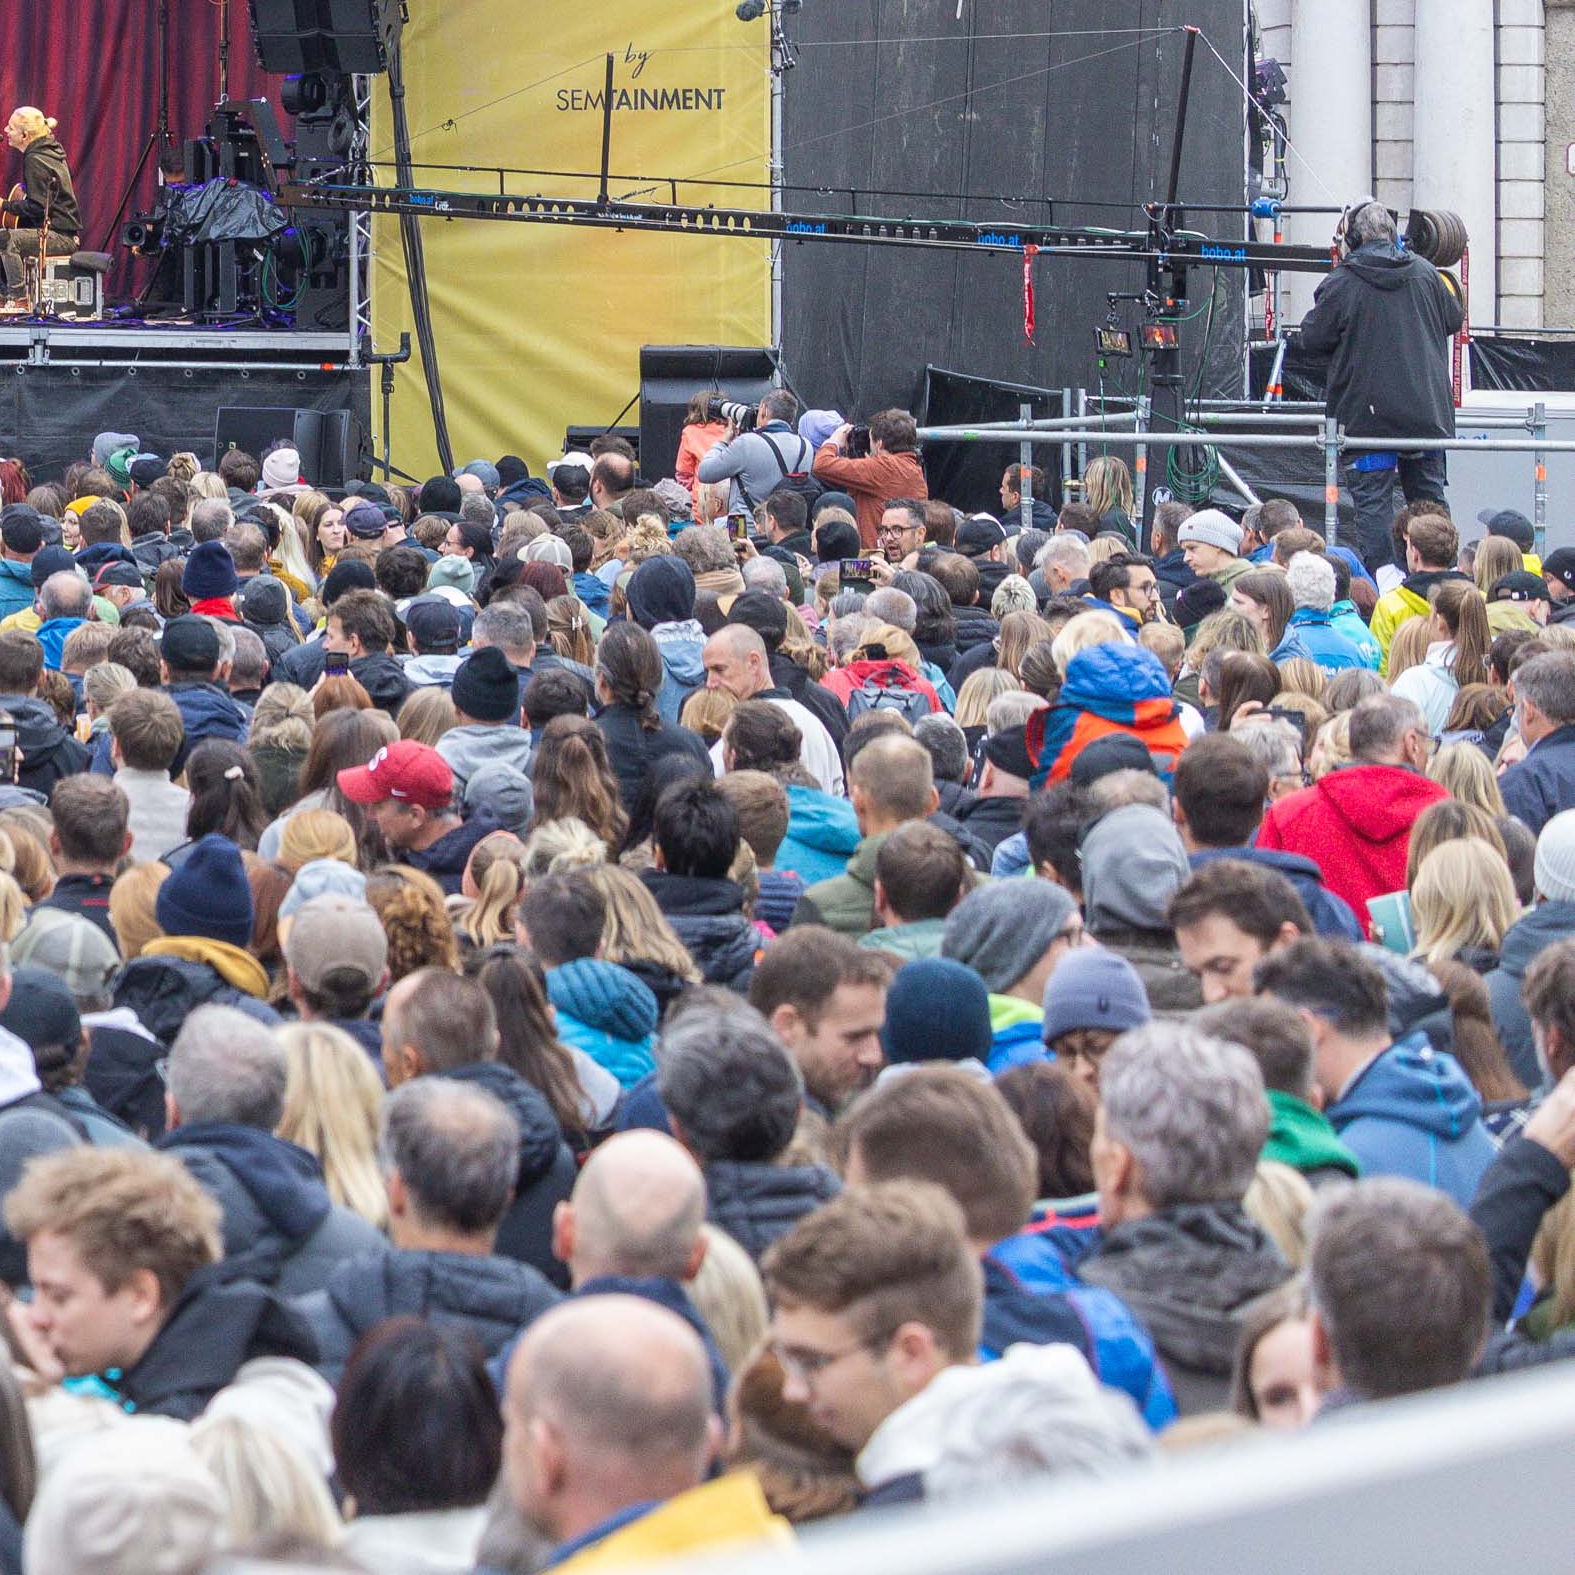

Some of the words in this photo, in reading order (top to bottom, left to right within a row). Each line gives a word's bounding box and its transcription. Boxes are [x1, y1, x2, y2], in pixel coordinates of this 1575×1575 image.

[624, 41, 653, 79] by
[555, 87, 726, 111] SEMTAINMENT
[1201, 244, 1246, 262] bobo.at
